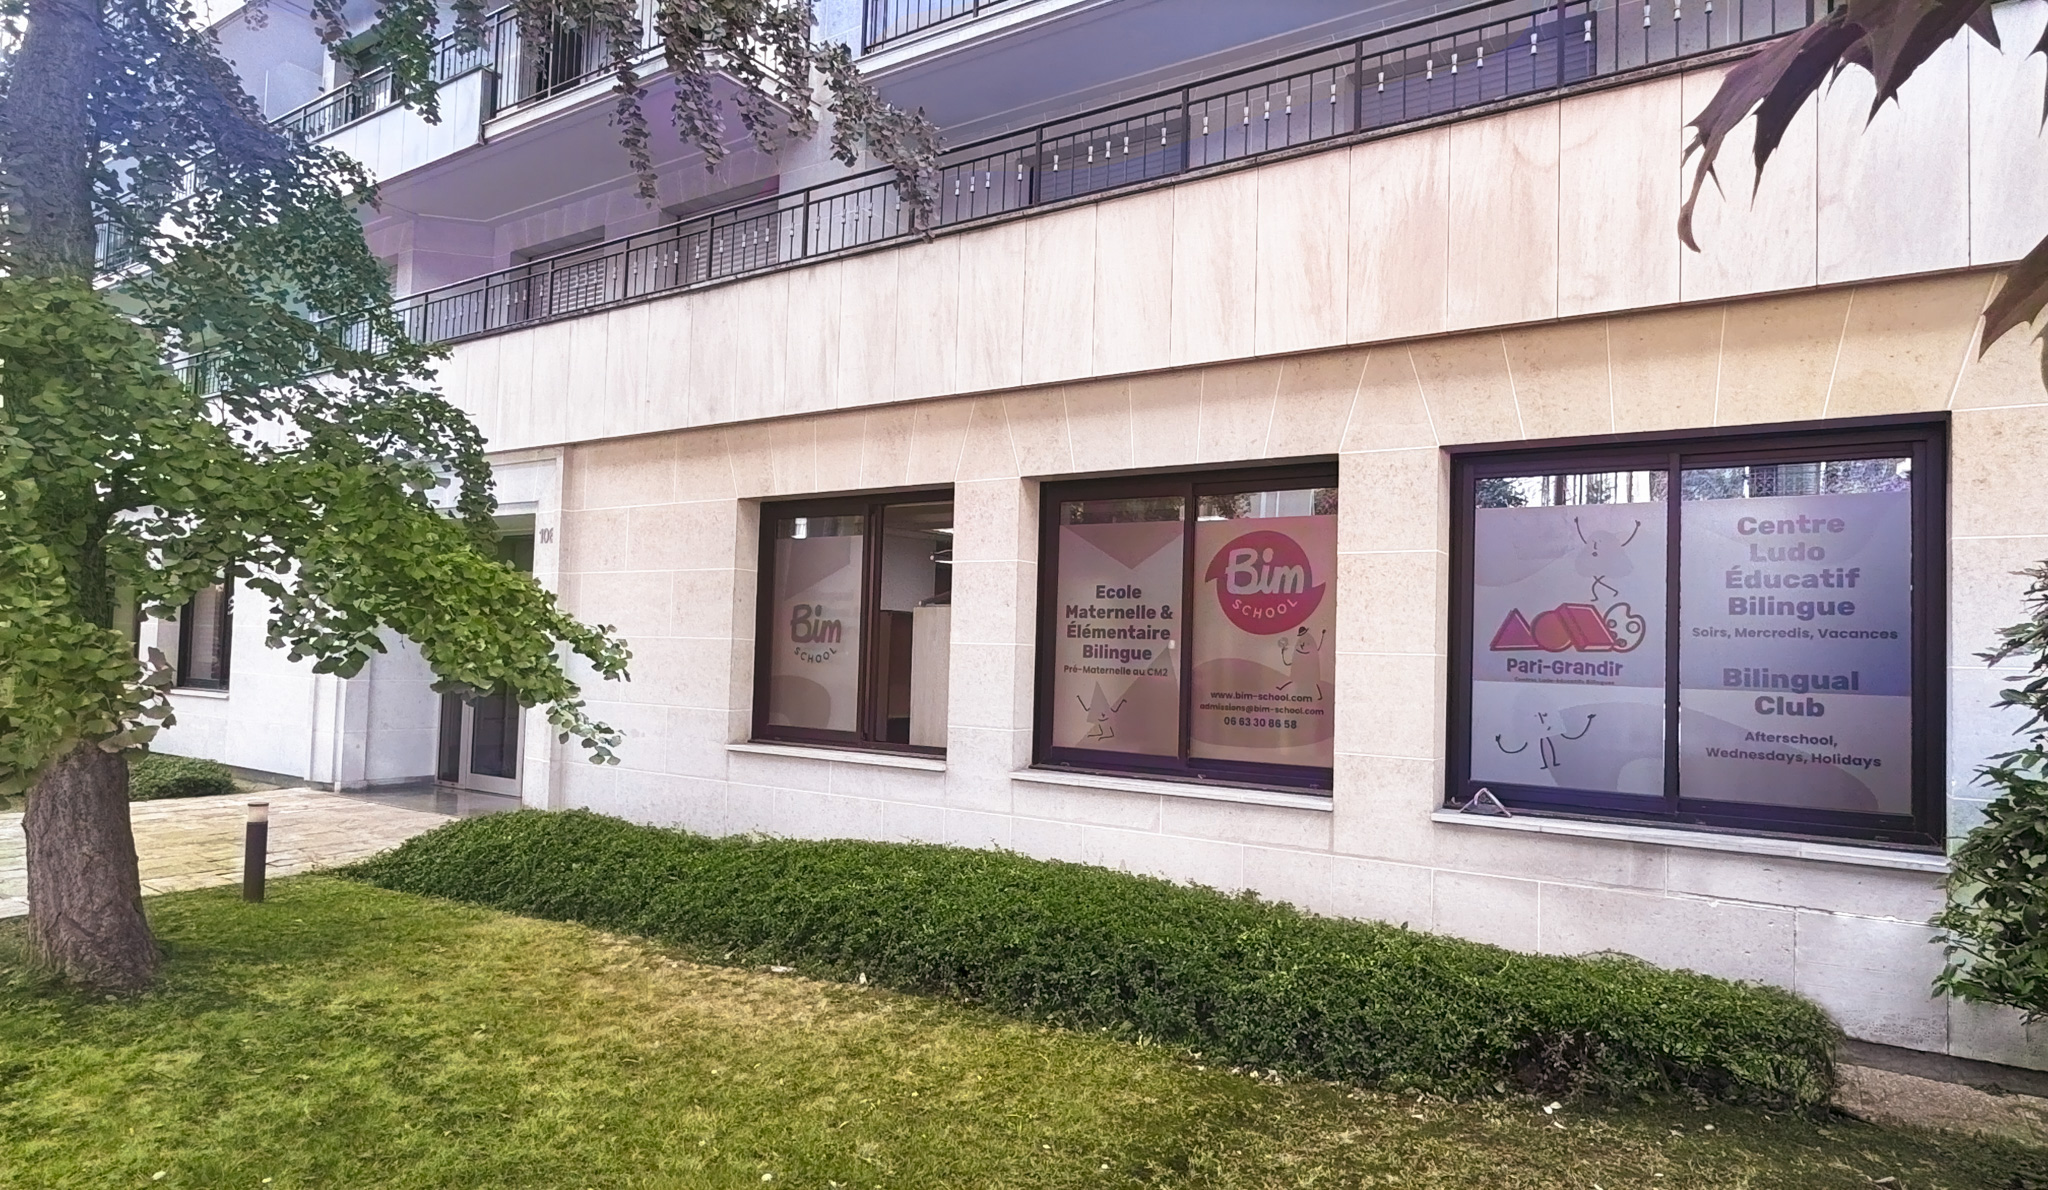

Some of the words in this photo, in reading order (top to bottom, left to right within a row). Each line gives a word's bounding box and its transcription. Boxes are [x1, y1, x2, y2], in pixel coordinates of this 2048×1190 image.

[1737, 514, 1845, 536] Centre
[1750, 542, 1826, 563] Ludo
[1225, 547, 1304, 595] Bim
[1725, 565, 1861, 589] Éducatif
[1095, 585, 1142, 599] Ecole
[1065, 605, 1157, 620] Maternelle
[1160, 605, 1173, 620] &
[1232, 599, 1298, 619] SCHOOL
[1728, 596, 1856, 621] Bilingue
[790, 604, 842, 643] Bim
[1066, 621, 1171, 640] Élémentaire
[1692, 627, 1731, 639] Soirs,
[1734, 627, 1814, 640] Mercredis,
[1817, 628, 1898, 640] Vacances
[794, 647, 837, 663] SCHOOL
[1082, 644, 1152, 663] Bilingue
[1063, 665, 1131, 676] Pré-Maternelle
[1147, 668, 1168, 677] CM2
[1506, 658, 1624, 677] Pari-Grandir
[1723, 668, 1860, 694] Bilingual
[1210, 691, 1313, 703] www.bim-school.com
[1754, 696, 1825, 717] Club
[1199, 703, 1325, 716] admissions@bim-school.com
[1223, 716, 1237, 726] 06
[1238, 717, 1251, 727] 63
[1252, 718, 1266, 728] 30
[1267, 719, 1282, 728] 86
[1283, 720, 1298, 729] 58
[1745, 731, 1838, 747] Afterschool,
[1705, 747, 1808, 764] Wednesdays,
[1811, 753, 1882, 770] Holidays
